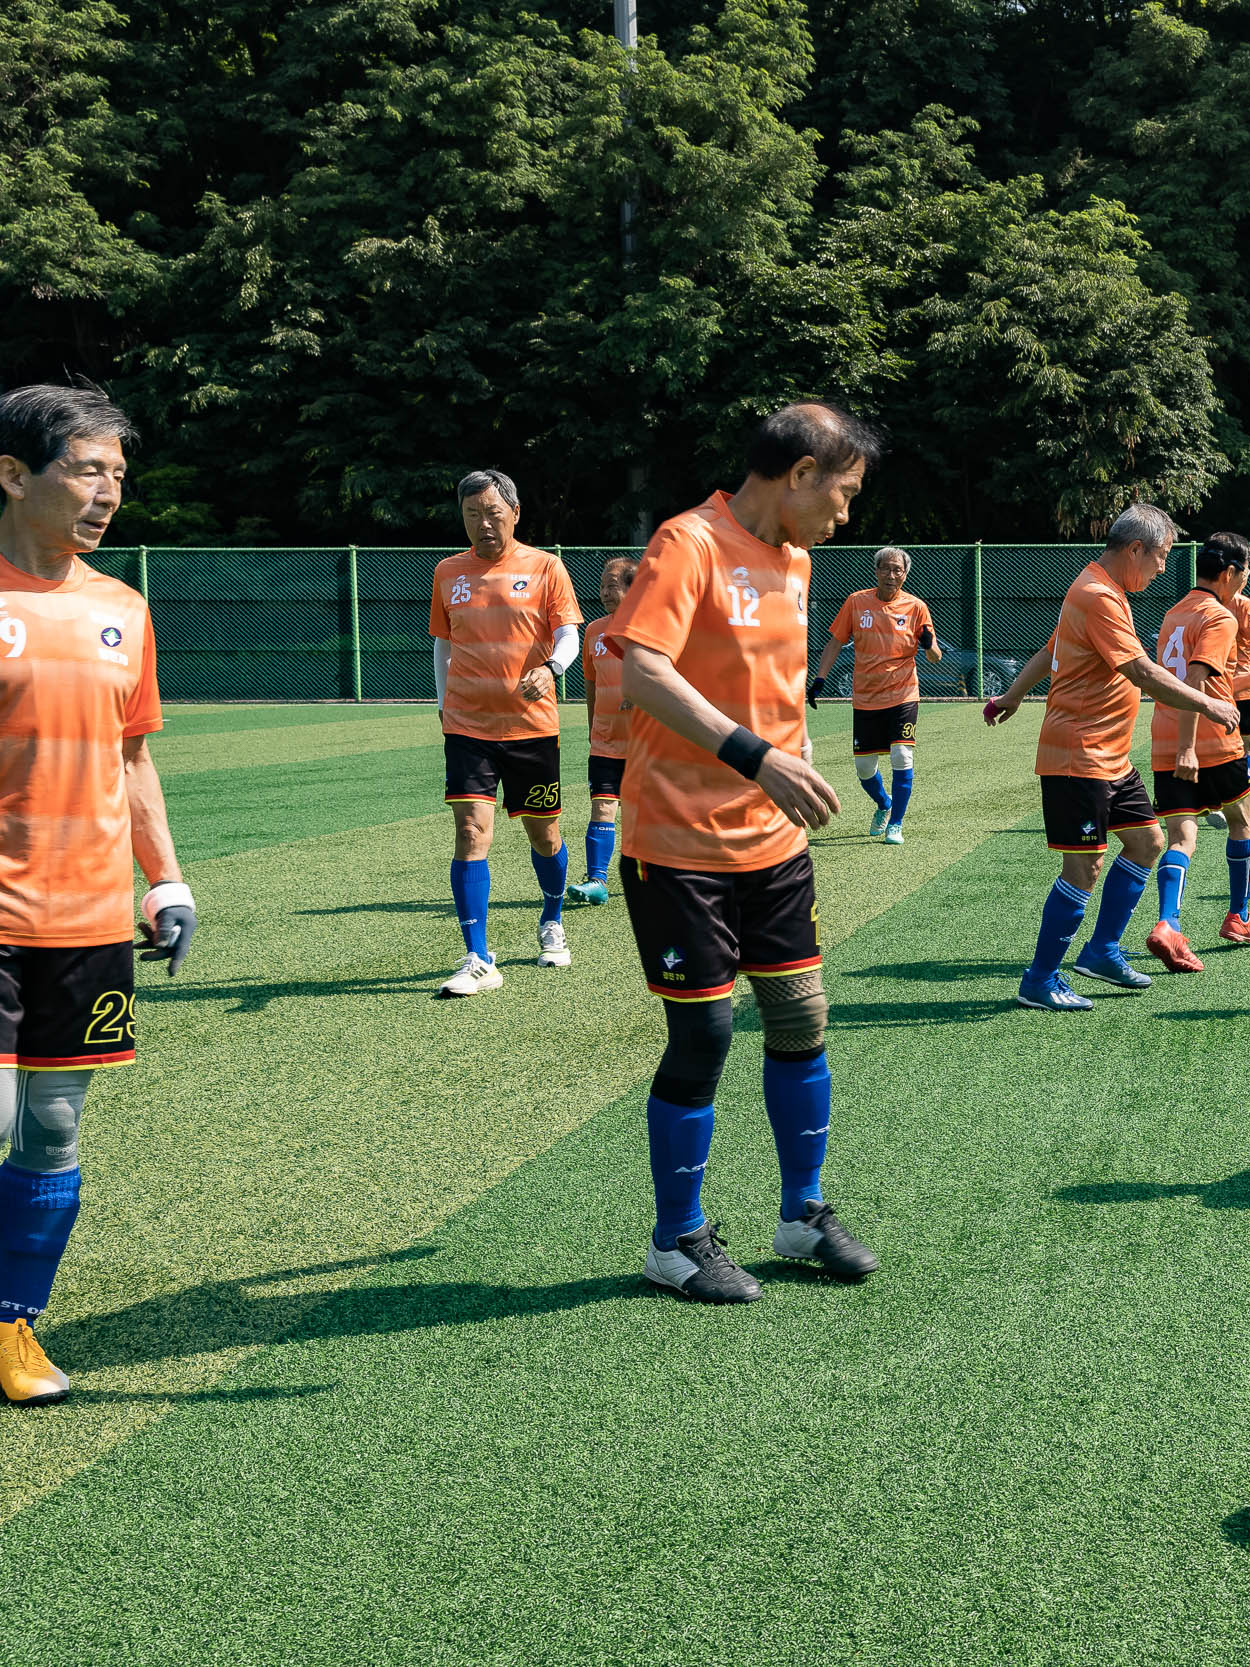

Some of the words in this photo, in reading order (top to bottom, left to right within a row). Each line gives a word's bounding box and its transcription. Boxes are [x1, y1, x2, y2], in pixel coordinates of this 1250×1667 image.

[451, 583, 471, 605] 25
[728, 585, 760, 627] 12
[860, 616, 873, 629] 30
[1162, 626, 1186, 681] 4
[524, 781, 559, 808] 25
[84, 990, 136, 1044] 2
